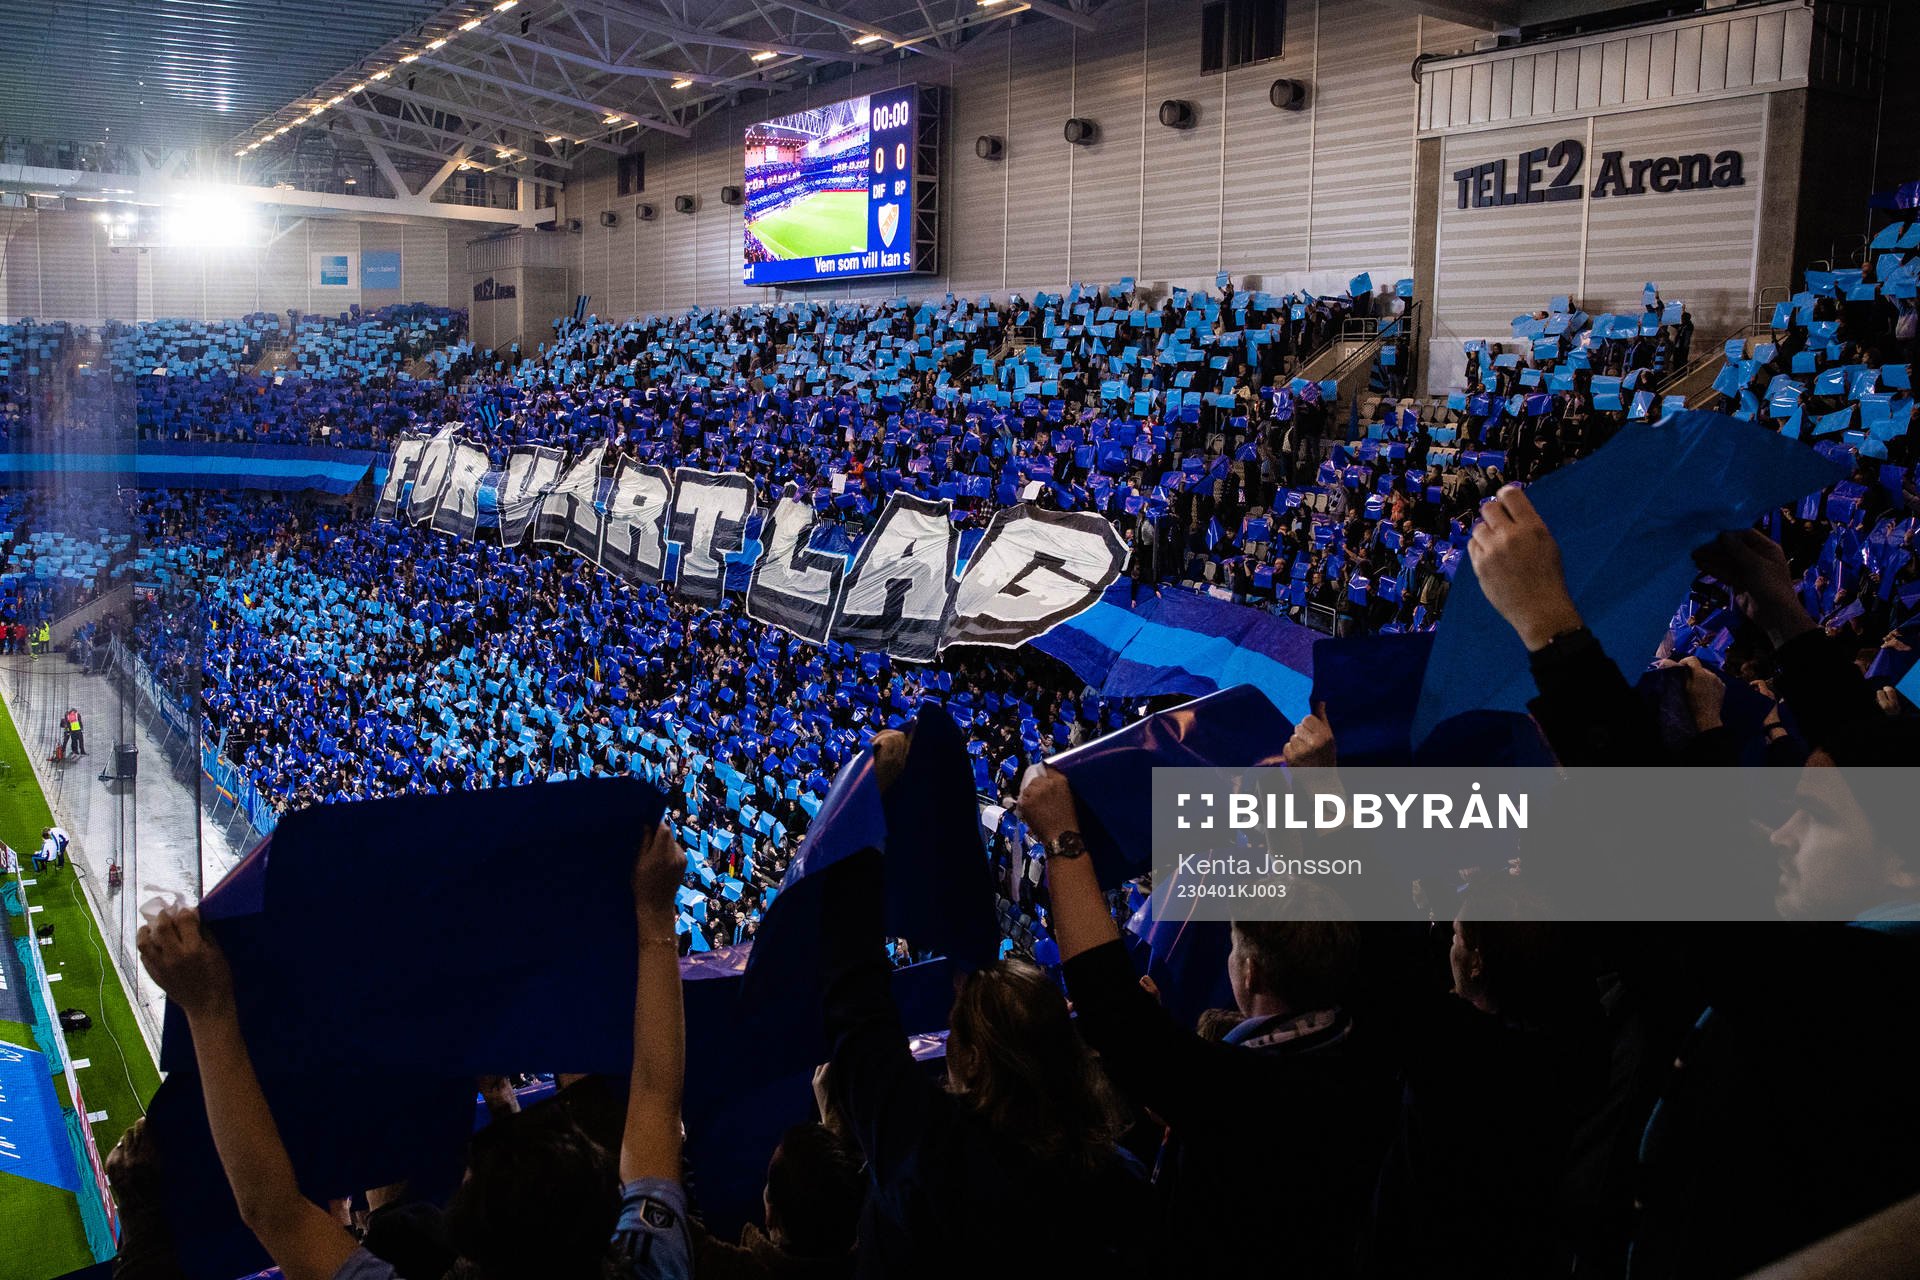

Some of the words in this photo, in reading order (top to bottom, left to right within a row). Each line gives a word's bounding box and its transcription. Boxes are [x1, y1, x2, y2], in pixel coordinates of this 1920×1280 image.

[873, 101, 909, 132] 00:00
[875, 147, 885, 174] 0
[896, 143, 905, 170] 0
[872, 183, 886, 199] DIF
[894, 180, 906, 196] BP
[1453, 139, 1584, 210] TELE2
[1590, 150, 1745, 199] Arena
[815, 257, 835, 273] Vem
[837, 257, 860, 271] som
[862, 252, 878, 269] vill
[881, 251, 900, 267] kan
